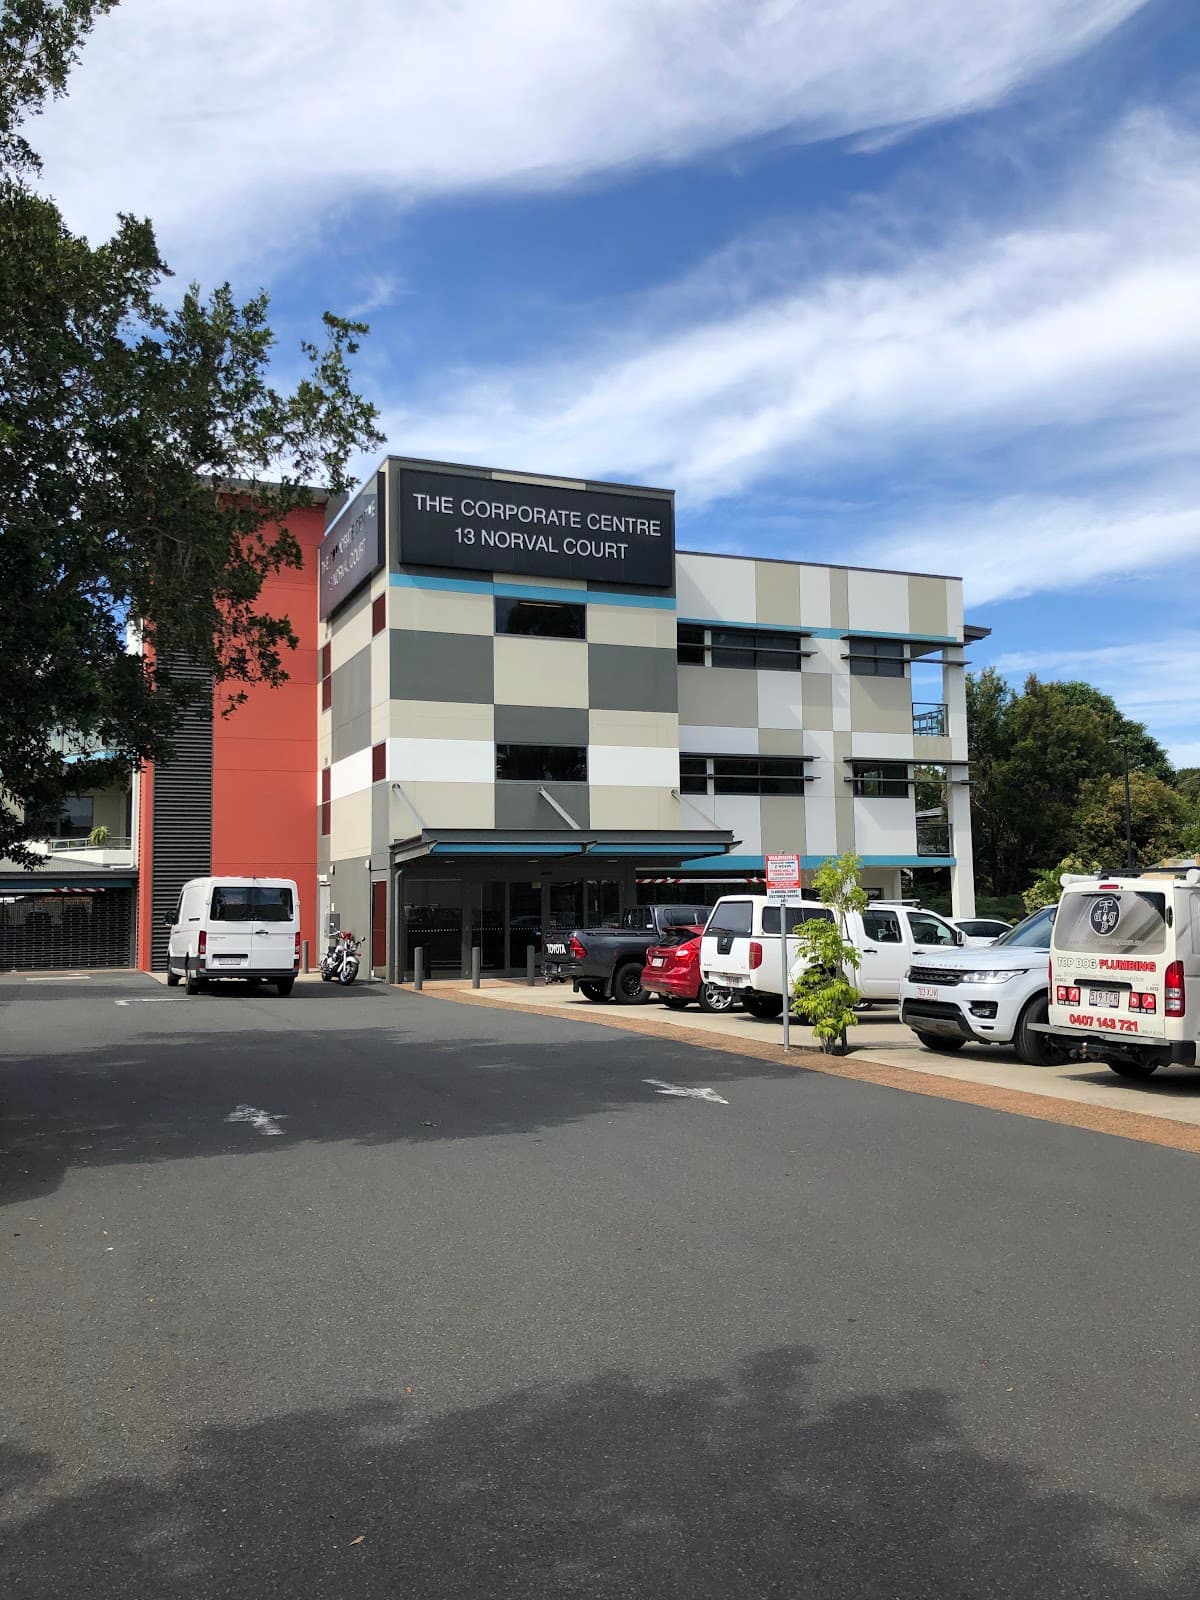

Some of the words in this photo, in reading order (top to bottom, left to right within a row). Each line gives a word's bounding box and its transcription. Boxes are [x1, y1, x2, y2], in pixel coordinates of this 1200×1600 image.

[412, 493, 454, 515] THE
[460, 498, 582, 529] CORPORATE
[586, 513, 662, 537] CENTRE
[454, 528, 475, 546] 13
[480, 529, 559, 554] NORVAL
[562, 538, 629, 560] COURT
[546, 944, 567, 955] TOYOTA
[1057, 957, 1074, 968] TOP
[1075, 958, 1098, 969] DOG
[1098, 959, 1157, 972] PLUMBING
[1069, 1013, 1095, 1027] 0407
[1096, 1016, 1116, 1029] 143
[1118, 1019, 1139, 1032] 721
